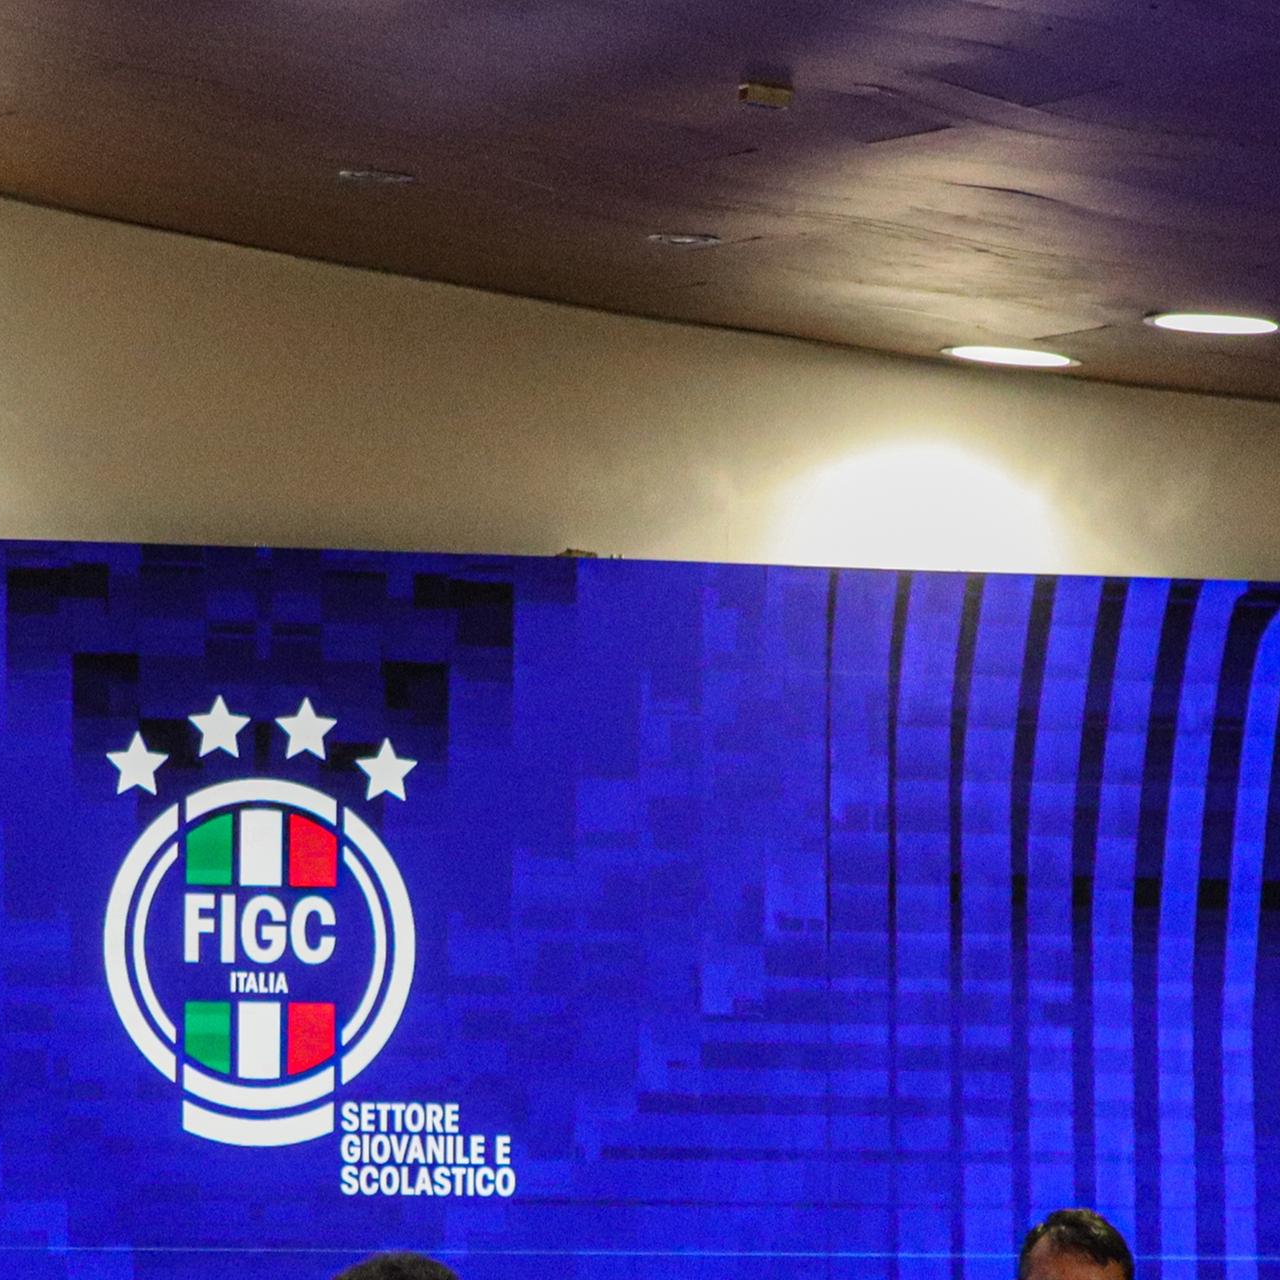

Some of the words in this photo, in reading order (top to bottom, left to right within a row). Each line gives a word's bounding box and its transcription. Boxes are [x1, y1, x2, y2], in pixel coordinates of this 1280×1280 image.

[183, 893, 336, 965] FIGC
[229, 971, 289, 994] ITALIA
[340, 1101, 459, 1133] SETTORE
[340, 1134, 485, 1165] GIOVANILE
[495, 1135, 511, 1165] E
[340, 1166, 516, 1197] SCOLASTICO
